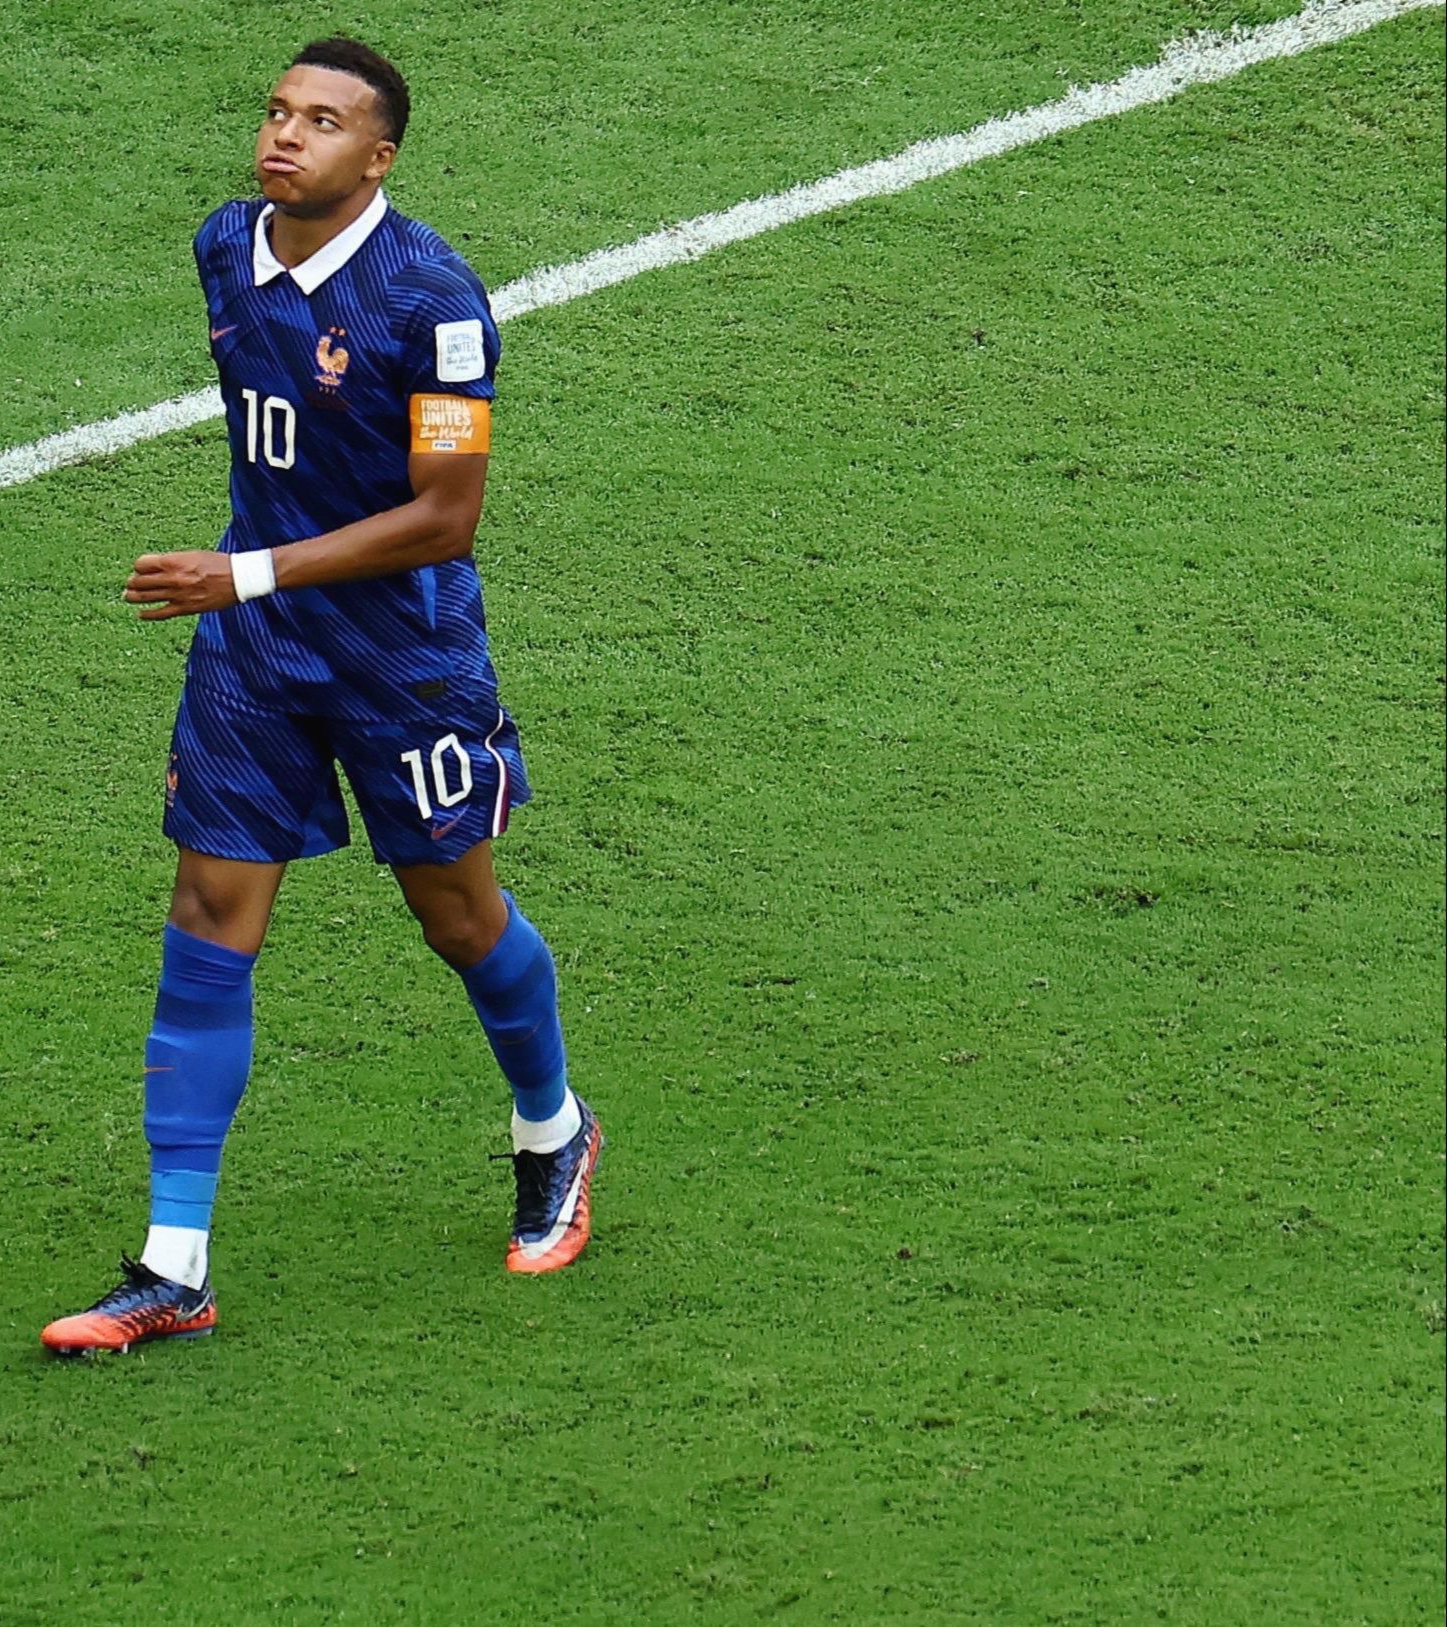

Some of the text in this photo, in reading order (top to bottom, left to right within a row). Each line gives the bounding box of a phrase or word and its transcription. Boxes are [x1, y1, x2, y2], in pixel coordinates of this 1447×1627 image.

[421, 399, 469, 411] FOOTBALL
[422, 410, 472, 426] UNITES
[242, 388, 295, 470] 10
[438, 426, 474, 440] World
[401, 733, 472, 819] 10
